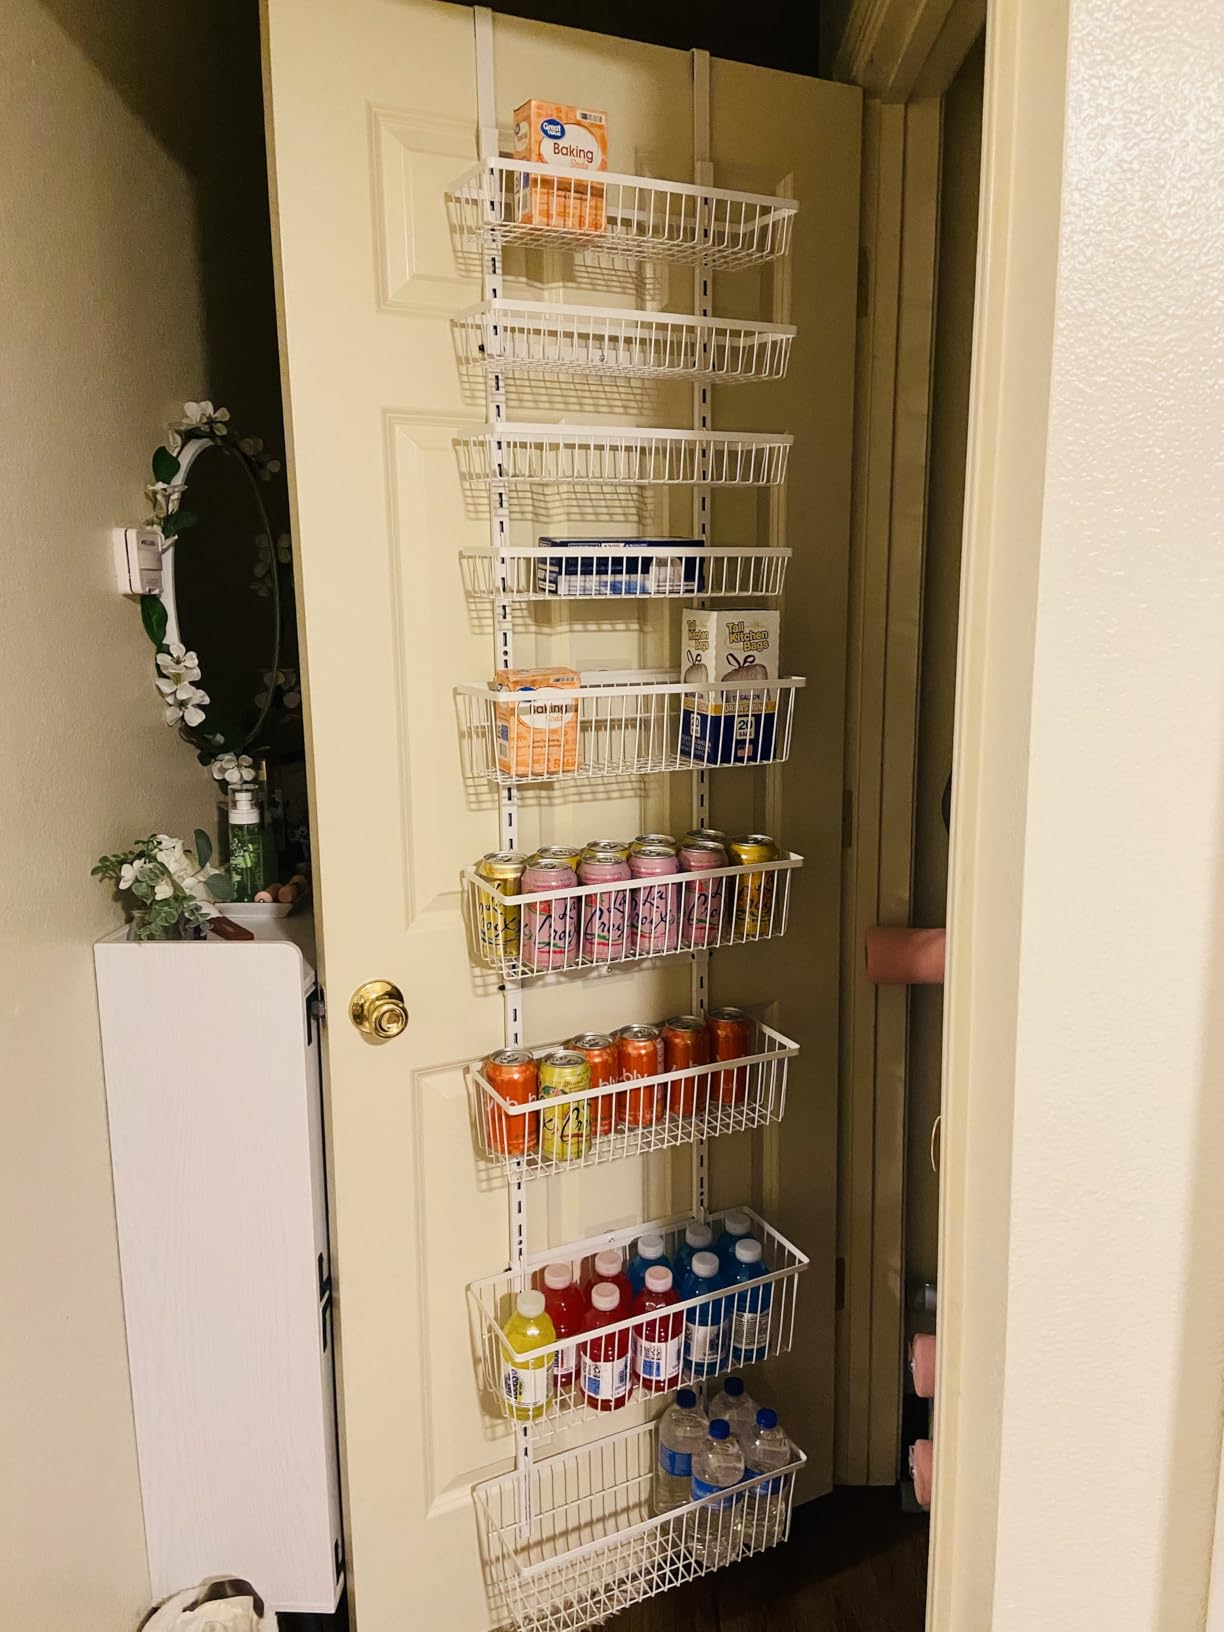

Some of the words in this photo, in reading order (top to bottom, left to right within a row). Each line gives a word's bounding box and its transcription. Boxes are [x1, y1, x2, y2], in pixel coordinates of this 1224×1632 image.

[553, 142, 593, 163] Baking
[726, 621, 744, 633] Tall
[729, 630, 769, 643] Kitchen
[743, 641, 769, 652] Bags
